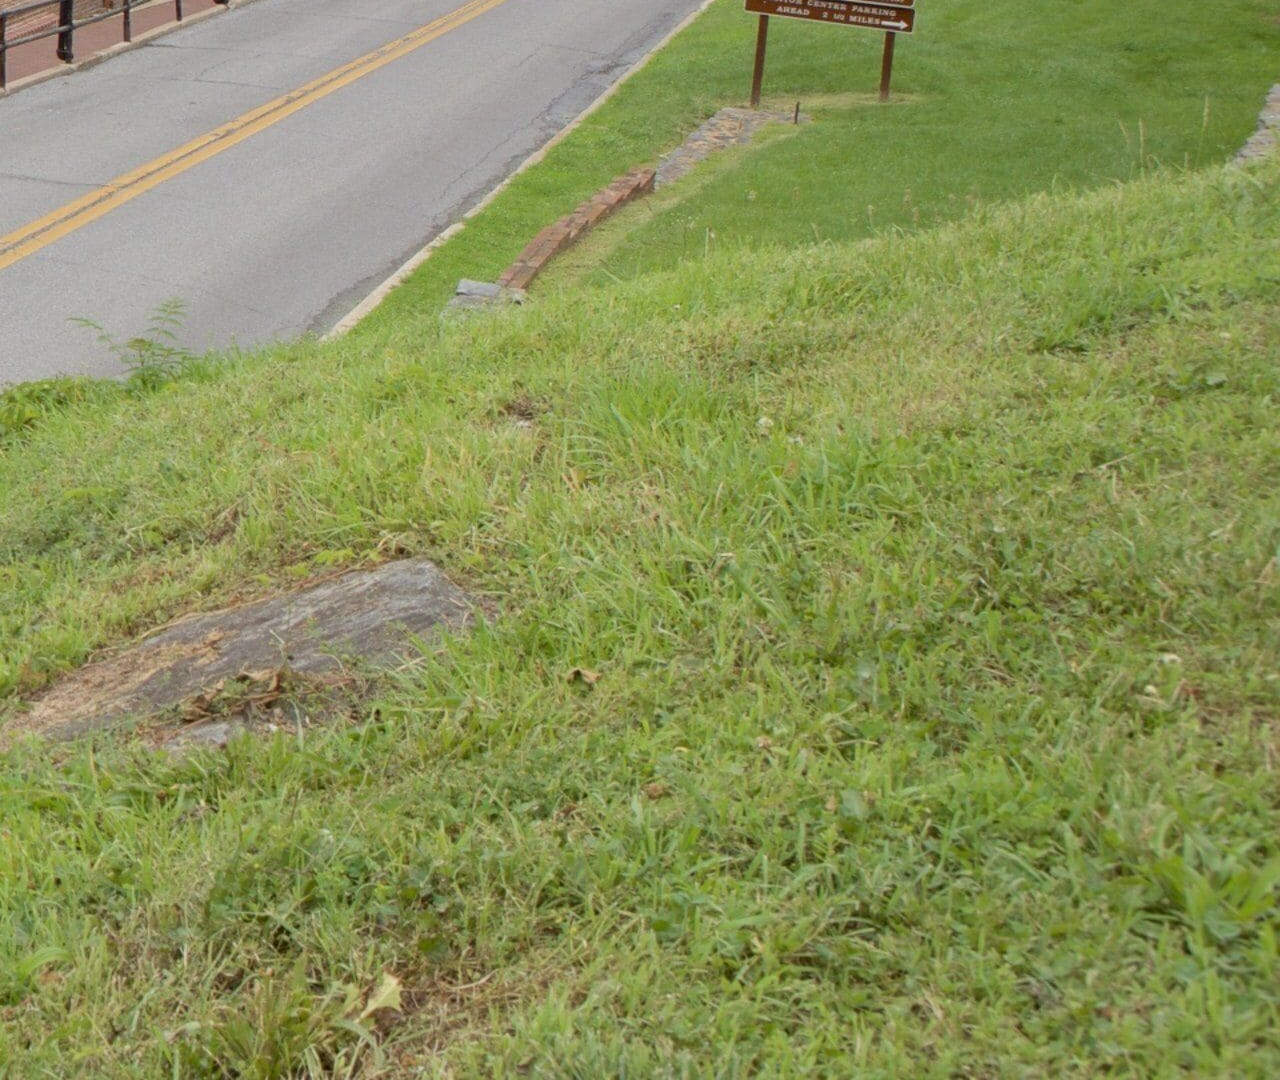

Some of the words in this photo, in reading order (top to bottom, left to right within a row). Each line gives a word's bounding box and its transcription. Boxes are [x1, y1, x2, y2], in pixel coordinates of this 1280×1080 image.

[776, 6, 810, 16] AHEAD
[849, 15, 881, 24] MILES
[807, 0, 847, 10] CENTER
[851, 5, 897, 16] PARKING
